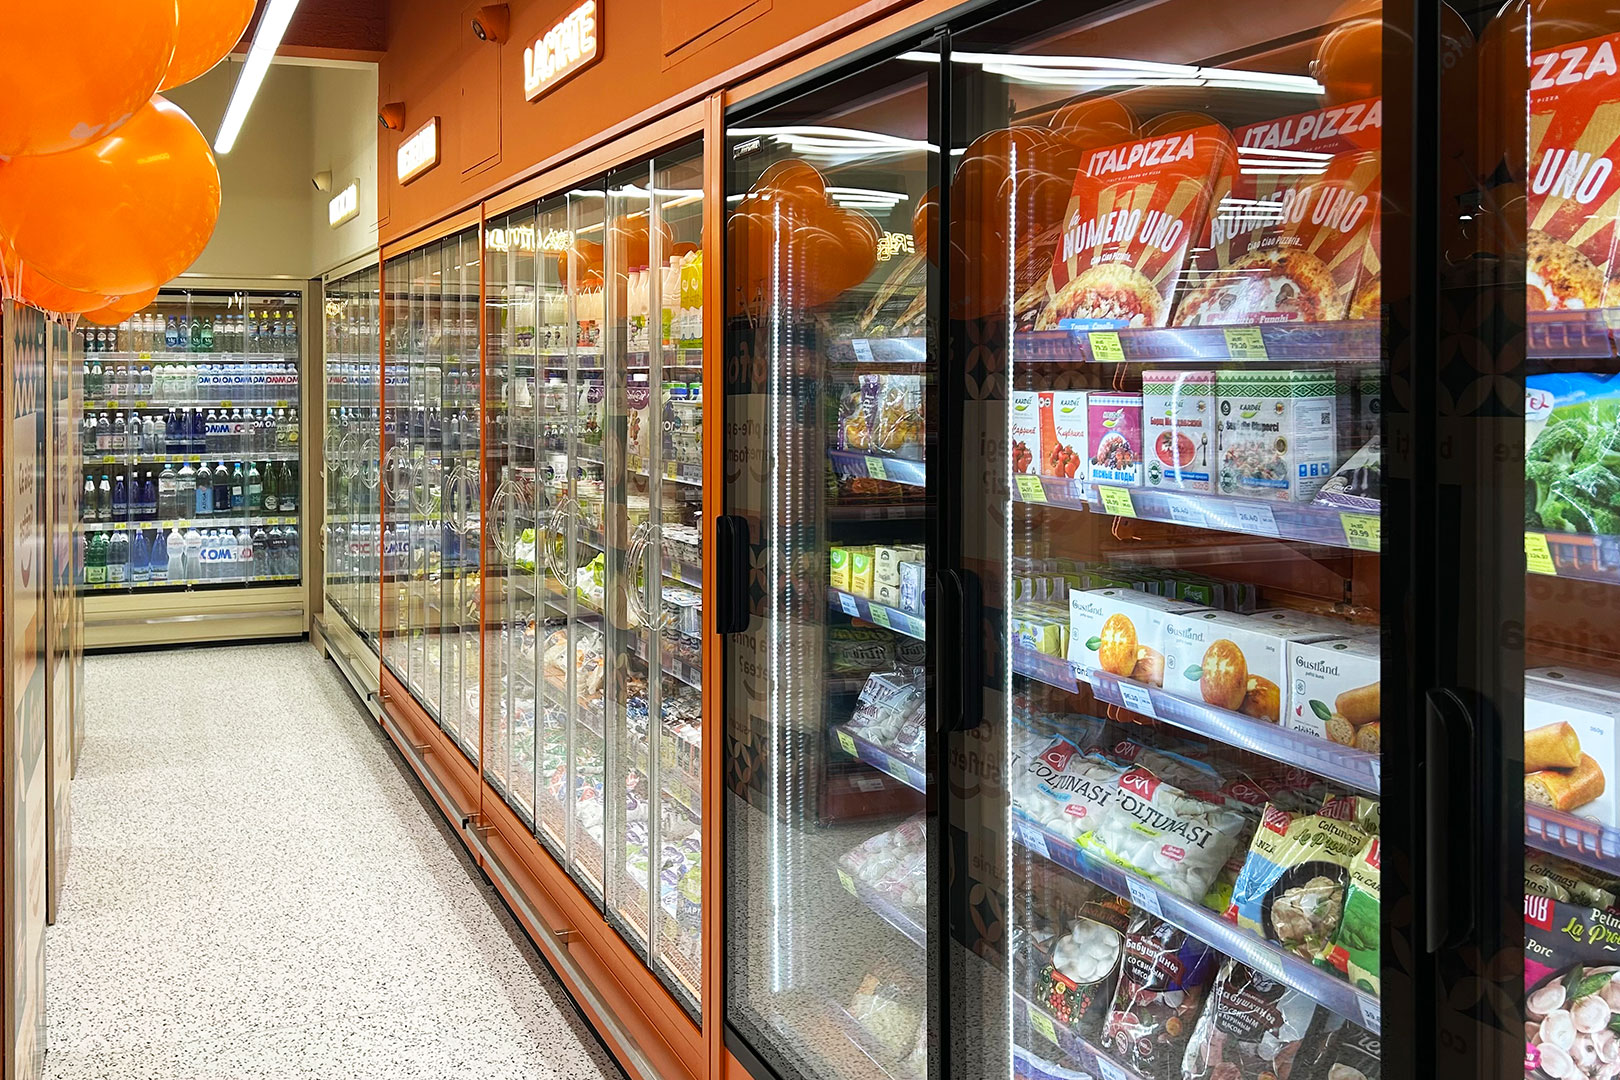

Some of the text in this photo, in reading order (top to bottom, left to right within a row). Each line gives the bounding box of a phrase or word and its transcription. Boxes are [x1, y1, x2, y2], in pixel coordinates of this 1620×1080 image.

[524, 0, 595, 92] LACTATE
[1242, 100, 1382, 153] ITALPIZZA
[1087, 133, 1195, 178] ITALPIZZA
[1532, 148, 1613, 204] UNO
[1211, 186, 1368, 249] NUMERO UNO
[1062, 209, 1183, 262] NUMERO UNO
[1092, 468, 1135, 482] ЛЕСНЫЕ ЯГОДЫ
[1239, 512, 1258, 523] 26.40
[1072, 599, 1102, 616] Gustland
[1166, 623, 1204, 641] Gustland
[1295, 655, 1339, 677] Gustland
[1561, 917, 1585, 942] La
[1526, 938, 1554, 957] Porc
